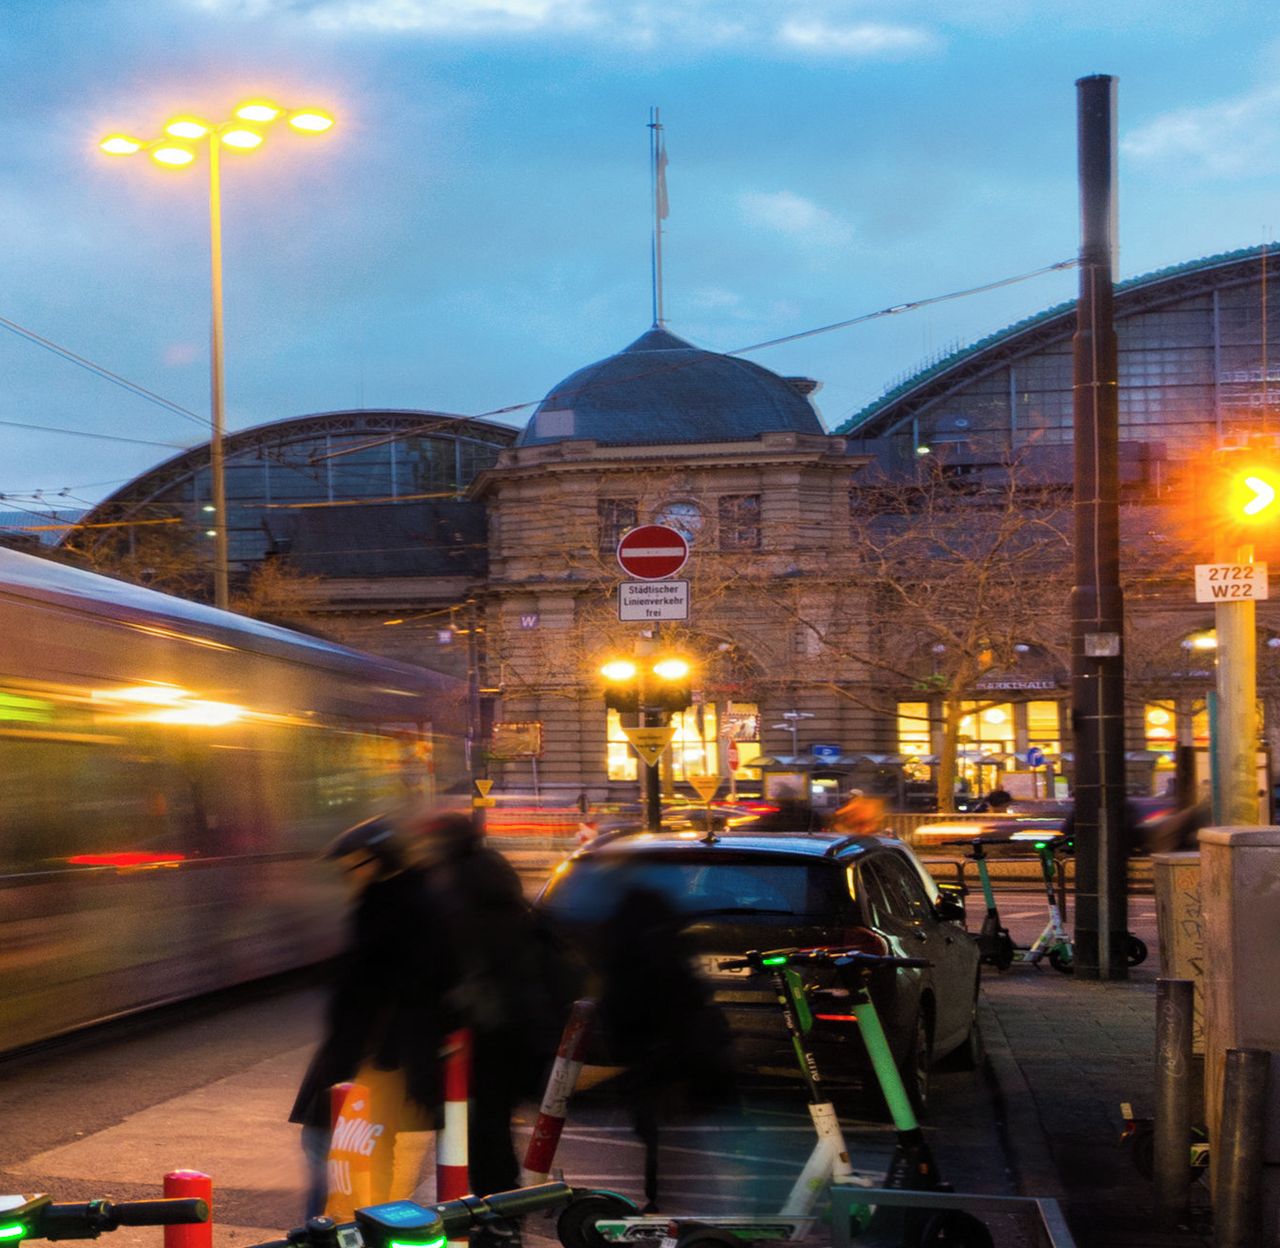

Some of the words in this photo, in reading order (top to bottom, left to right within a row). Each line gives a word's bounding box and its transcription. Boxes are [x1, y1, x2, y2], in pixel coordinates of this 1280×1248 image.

[1209, 566, 1254, 581] 2722
[629, 585, 679, 594] Städtischer
[1212, 583, 1252, 598] W22
[623, 597, 684, 606] Linienverkehr
[645, 609, 662, 617] frei
